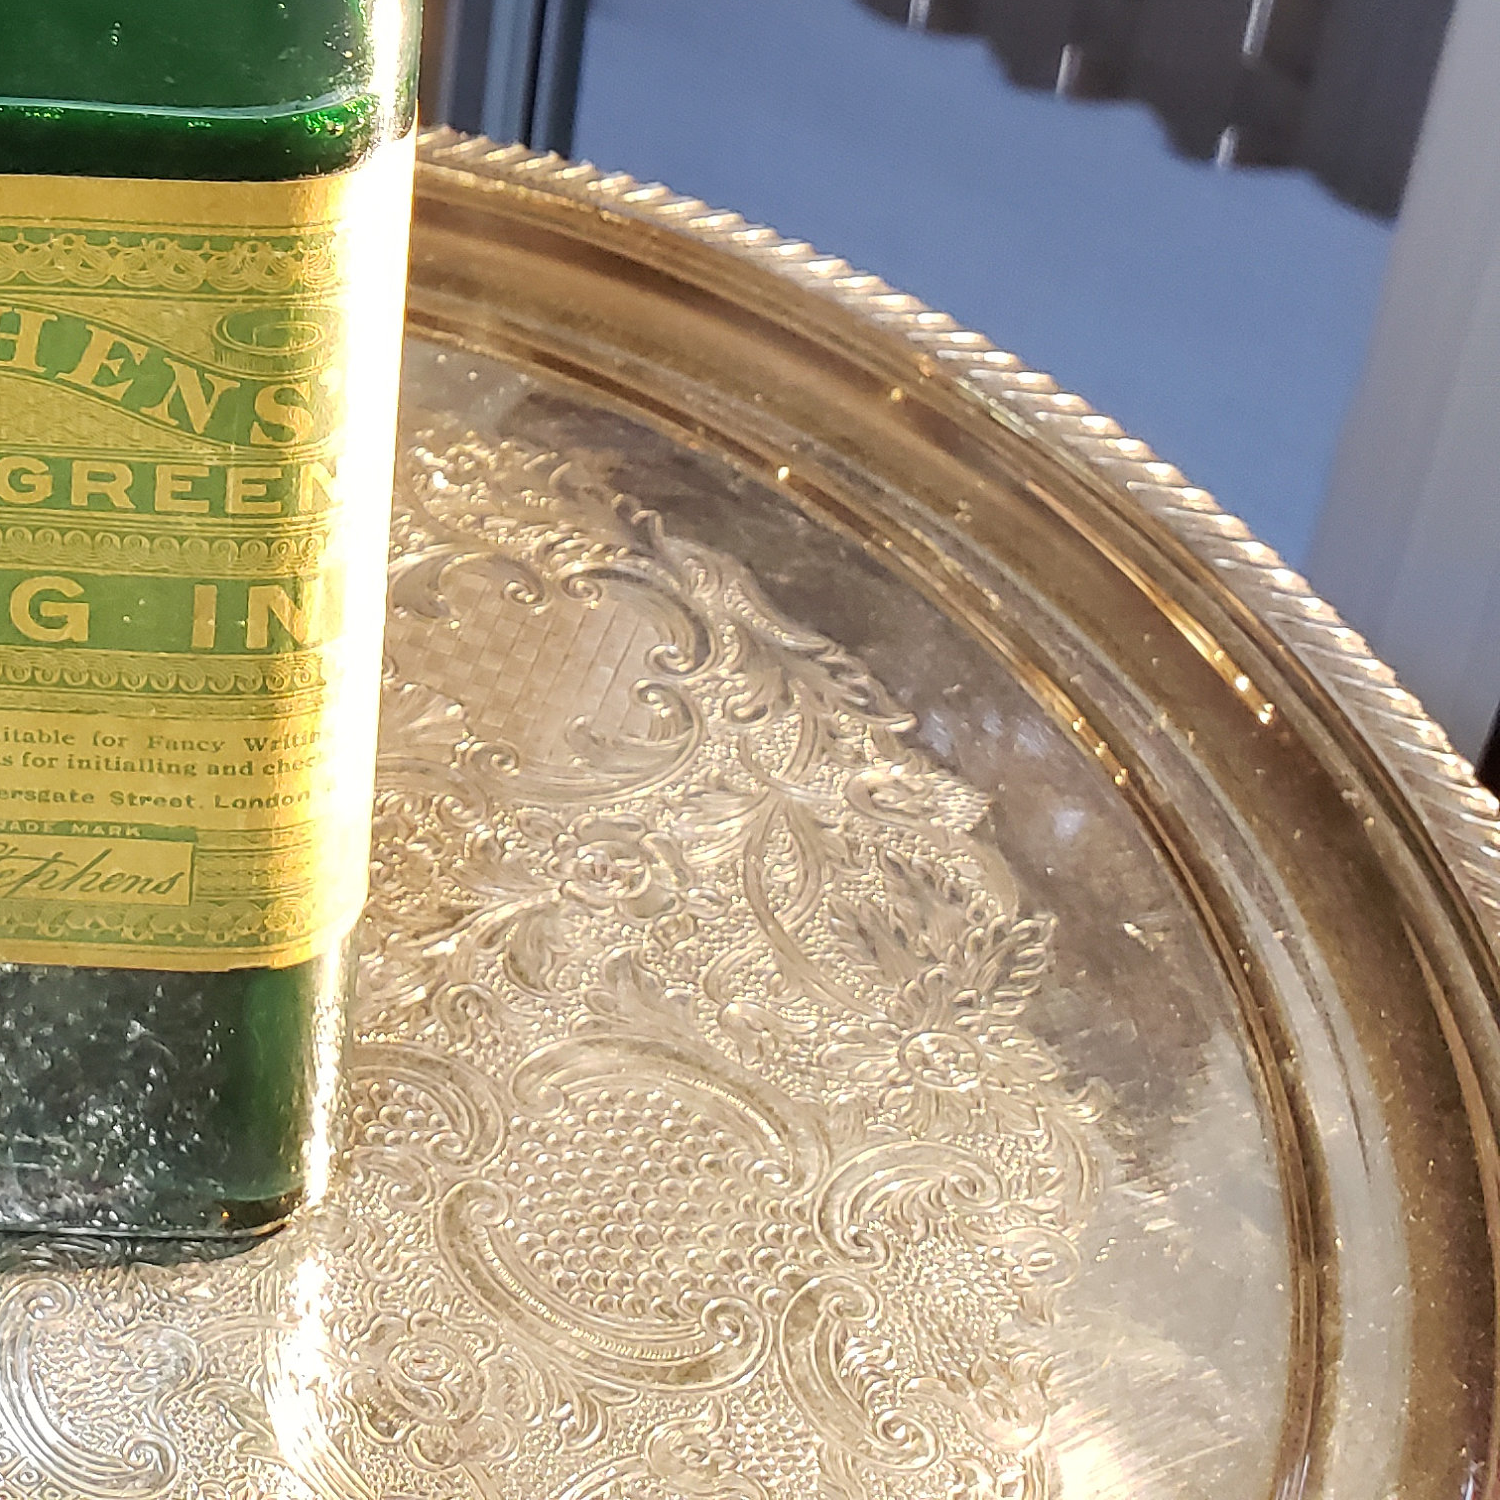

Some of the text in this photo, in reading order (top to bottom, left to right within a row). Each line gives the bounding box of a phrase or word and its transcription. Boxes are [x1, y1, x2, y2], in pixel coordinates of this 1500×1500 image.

[93, 730, 128, 747] for
[147, 736, 225, 753] Fancy
[22, 752, 59, 769] for
[67, 753, 197, 776] initialling
[207, 760, 253, 777] and
[70, 823, 142, 836] MARK
